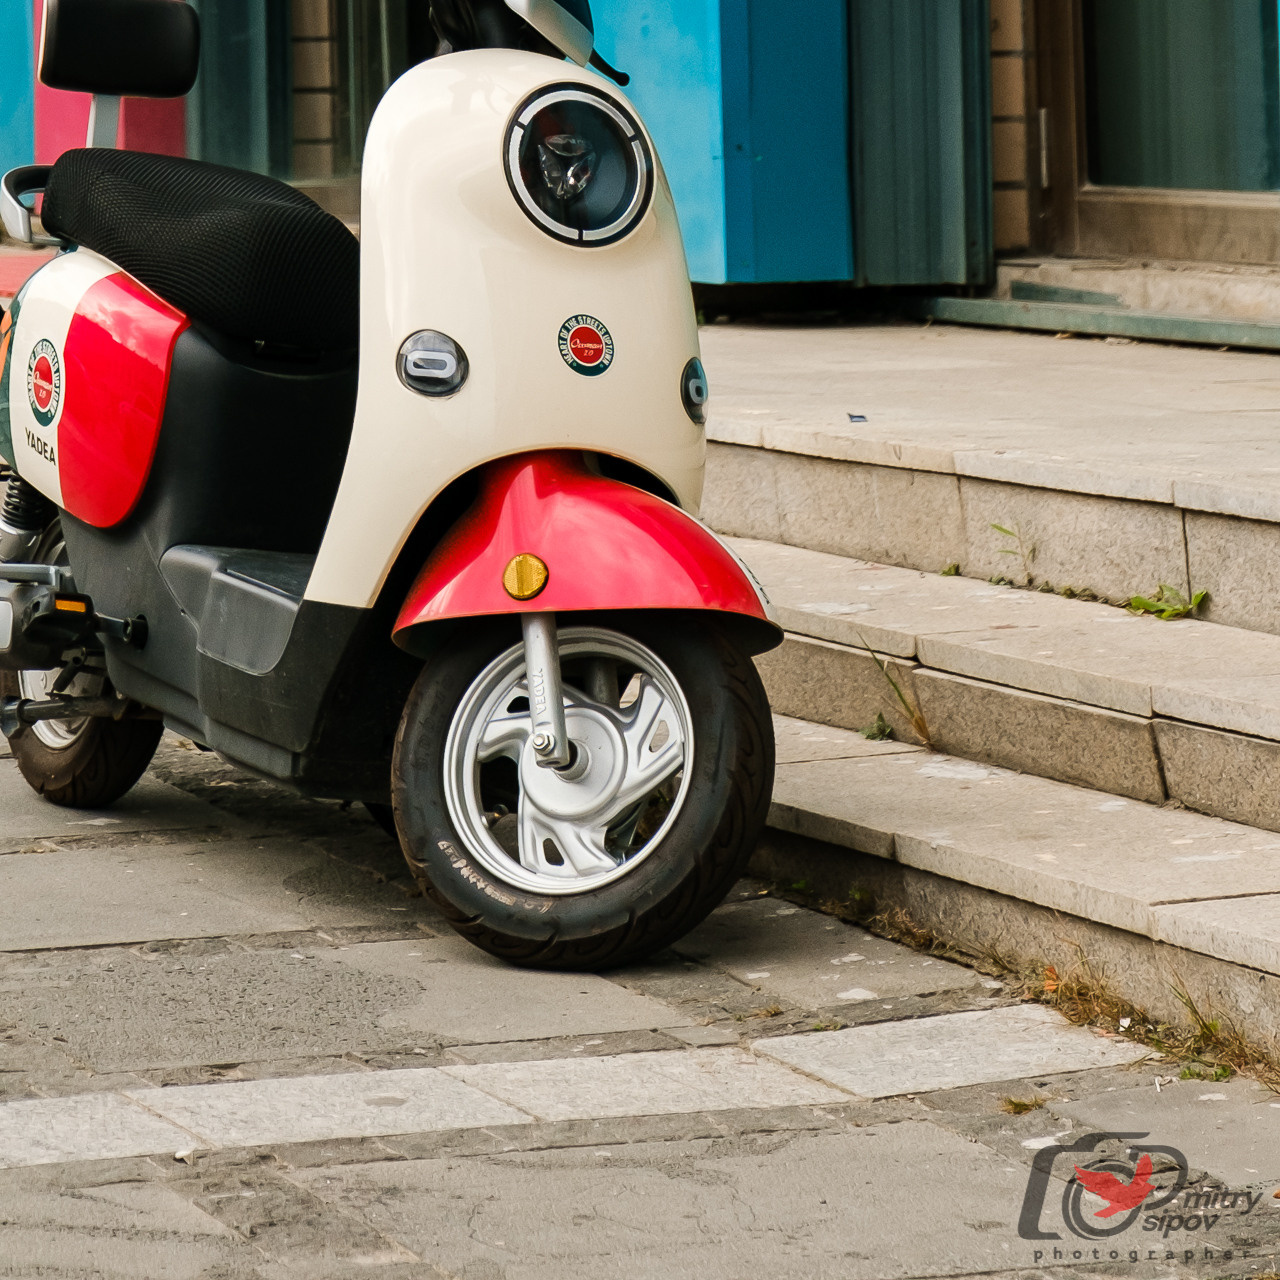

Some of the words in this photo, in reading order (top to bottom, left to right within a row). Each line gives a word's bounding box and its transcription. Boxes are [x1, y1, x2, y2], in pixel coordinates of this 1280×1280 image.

[578, 316, 606, 334] STREETS
[25, 427, 56, 467] YADEA
[532, 668, 547, 716] YADEA
